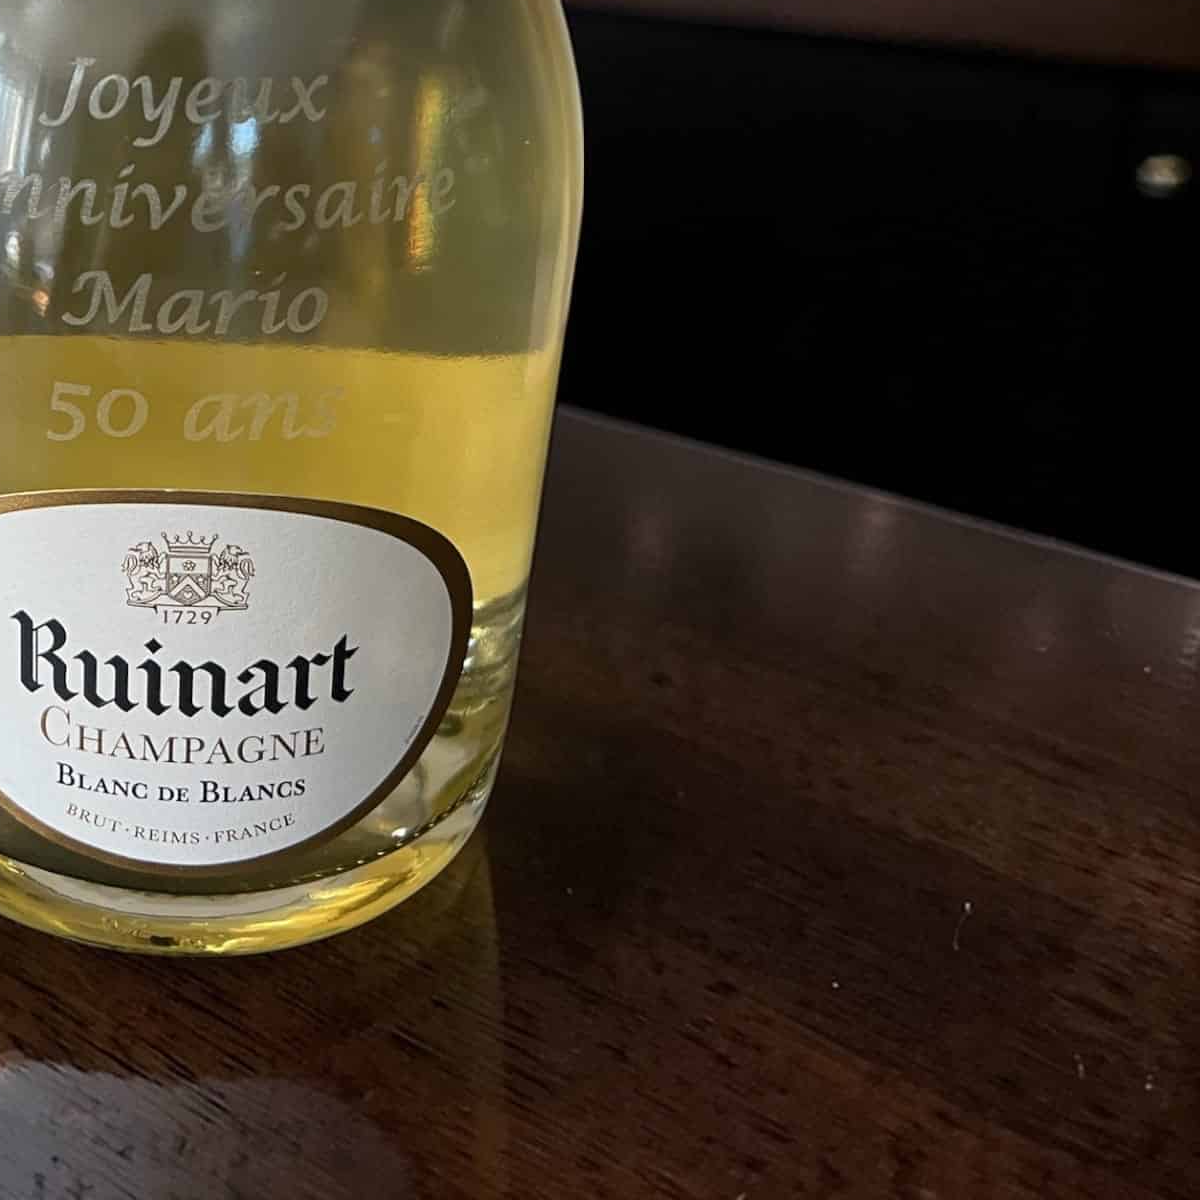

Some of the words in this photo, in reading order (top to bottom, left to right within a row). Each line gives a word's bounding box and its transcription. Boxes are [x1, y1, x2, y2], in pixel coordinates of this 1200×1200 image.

[38, 56, 329, 147] Joyeux
[61, 269, 329, 336] Mario
[45, 381, 149, 443] 50
[183, 384, 348, 443] ans
[162, 609, 213, 625] 1729
[10, 608, 361, 719] Ruinart
[40, 704, 326, 765] CHAMPAGNE
[55, 760, 149, 800] BLANC
[158, 785, 190, 802] DE
[199, 778, 307, 804] BLANCS
